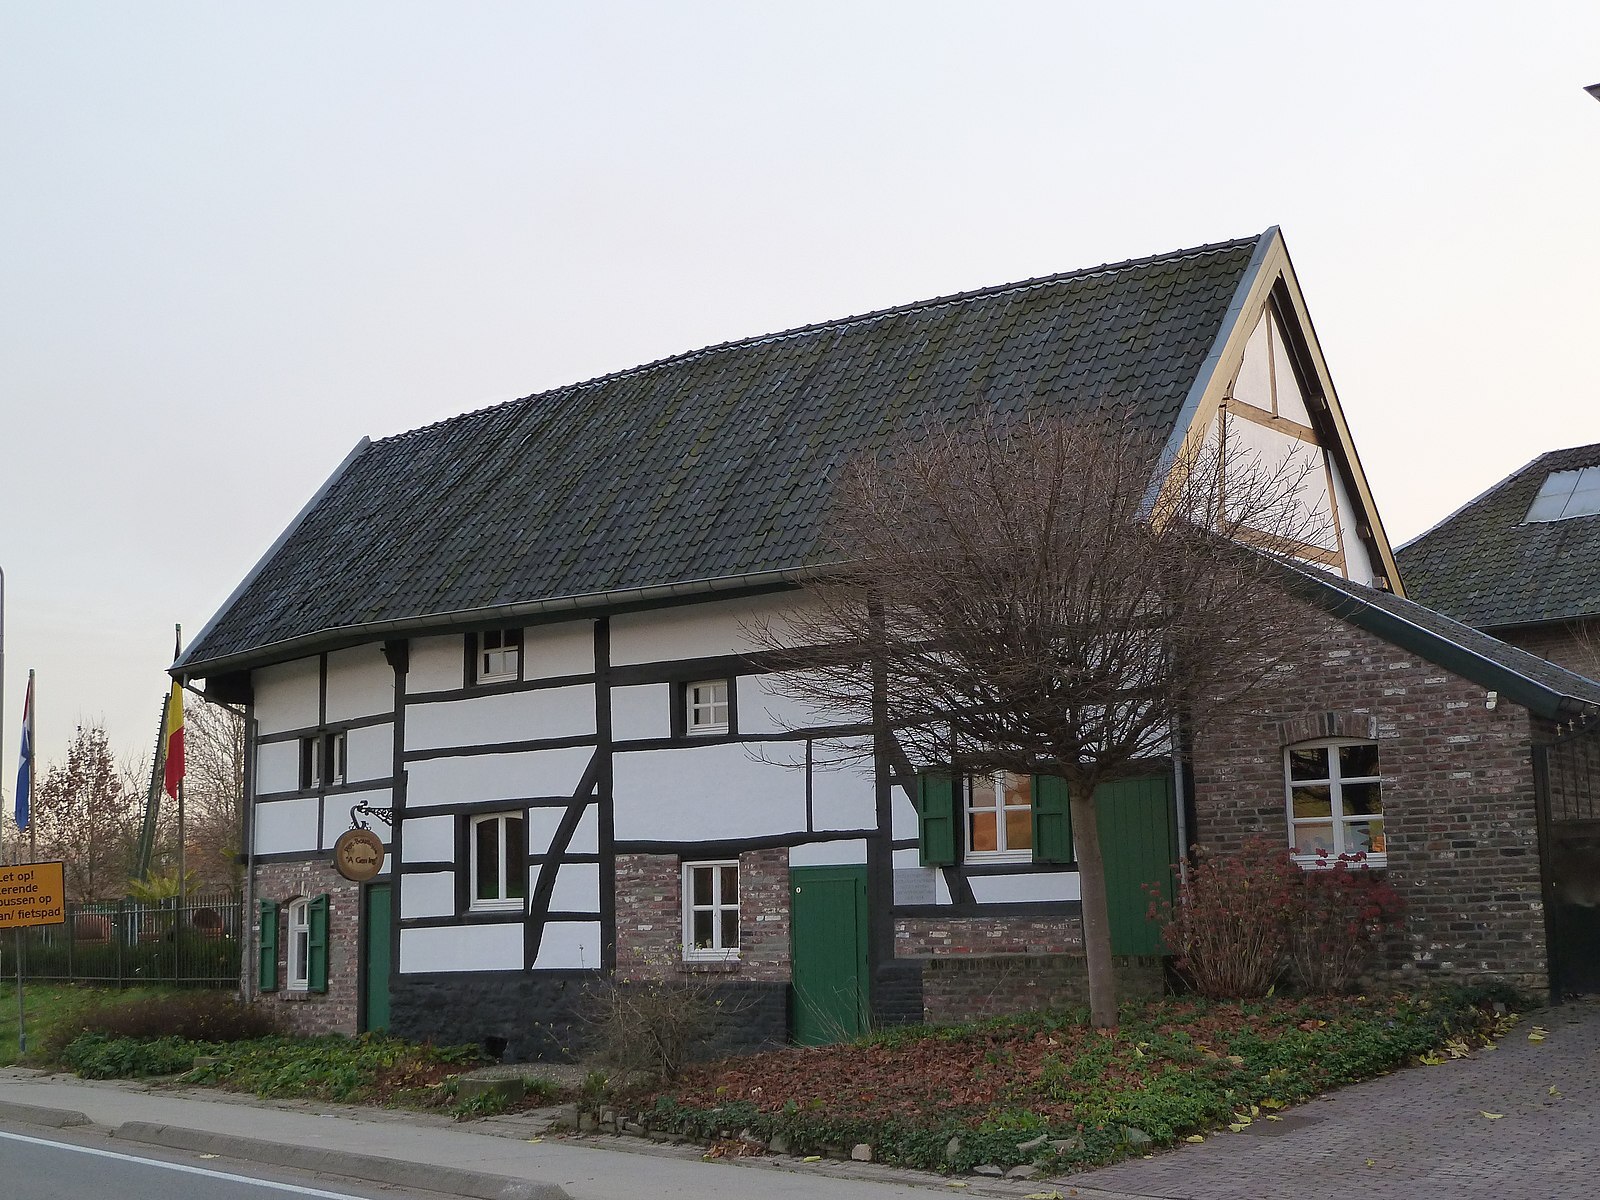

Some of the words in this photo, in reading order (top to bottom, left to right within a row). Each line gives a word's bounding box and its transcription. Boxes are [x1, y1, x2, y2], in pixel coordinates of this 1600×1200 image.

[17, 870, 34, 882] op!
[0, 884, 38, 895] erende
[38, 895, 52, 905] op
[18, 907, 61, 919] fietspad
